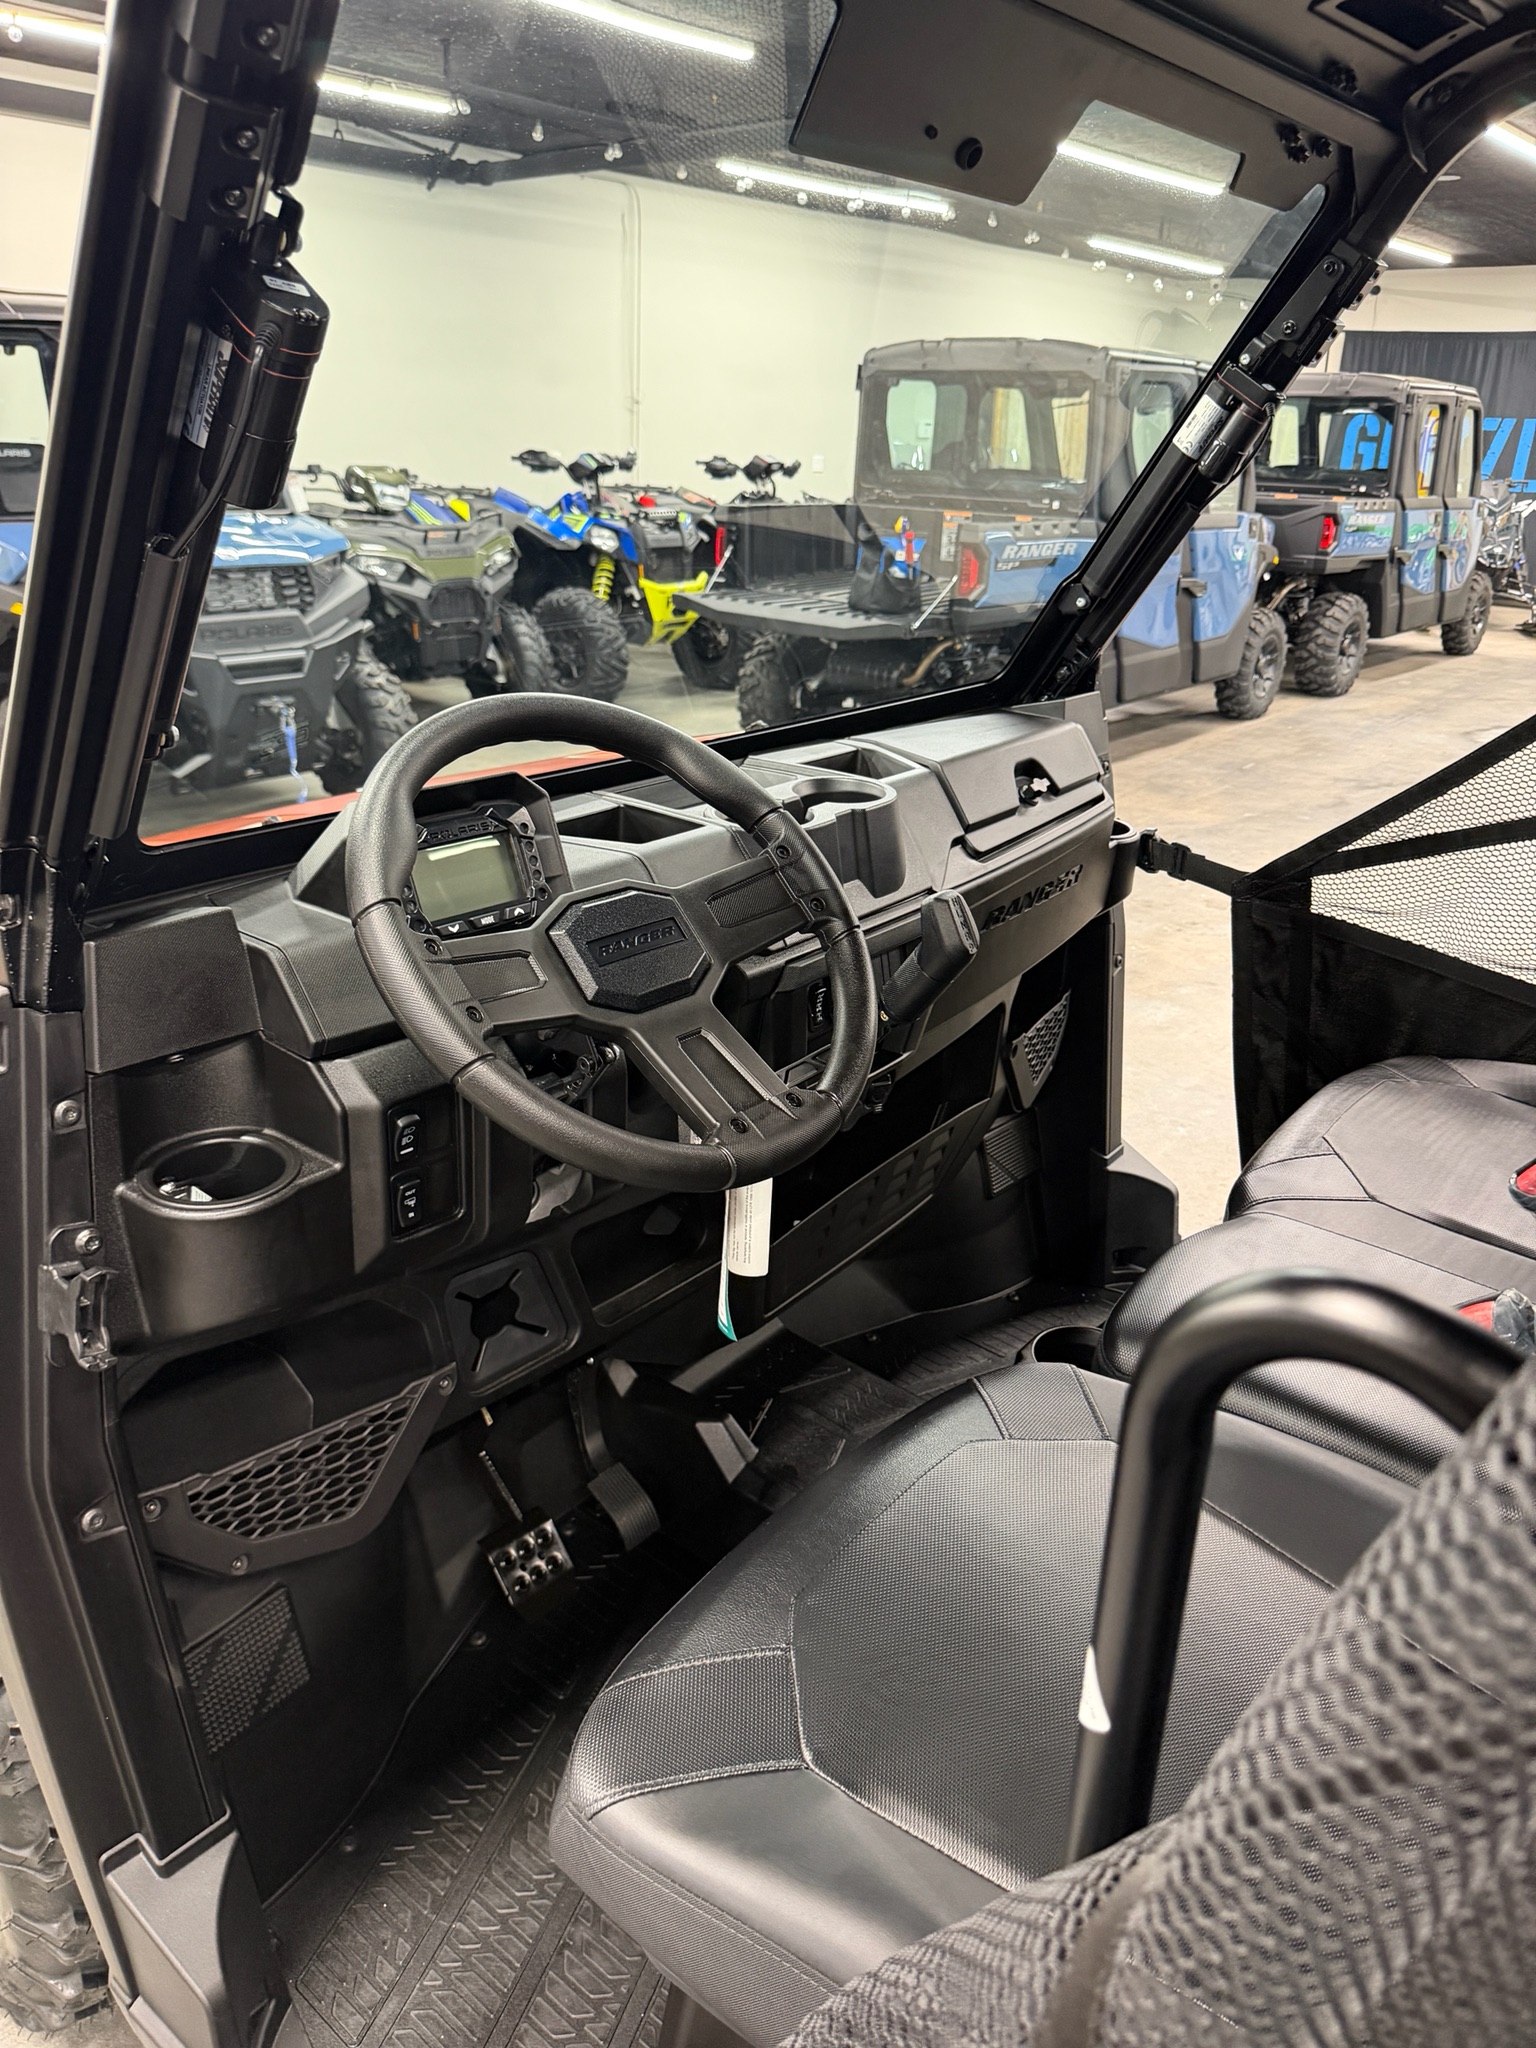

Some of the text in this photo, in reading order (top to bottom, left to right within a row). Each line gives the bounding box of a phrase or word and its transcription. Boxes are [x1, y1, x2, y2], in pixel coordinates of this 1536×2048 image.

[1001, 543, 1077, 560] RANGER
[430, 822, 490, 840] POLARIS
[980, 864, 1084, 931] RANGER
[599, 926, 676, 957] RANGER
[404, 1188, 416, 1196] OUT
